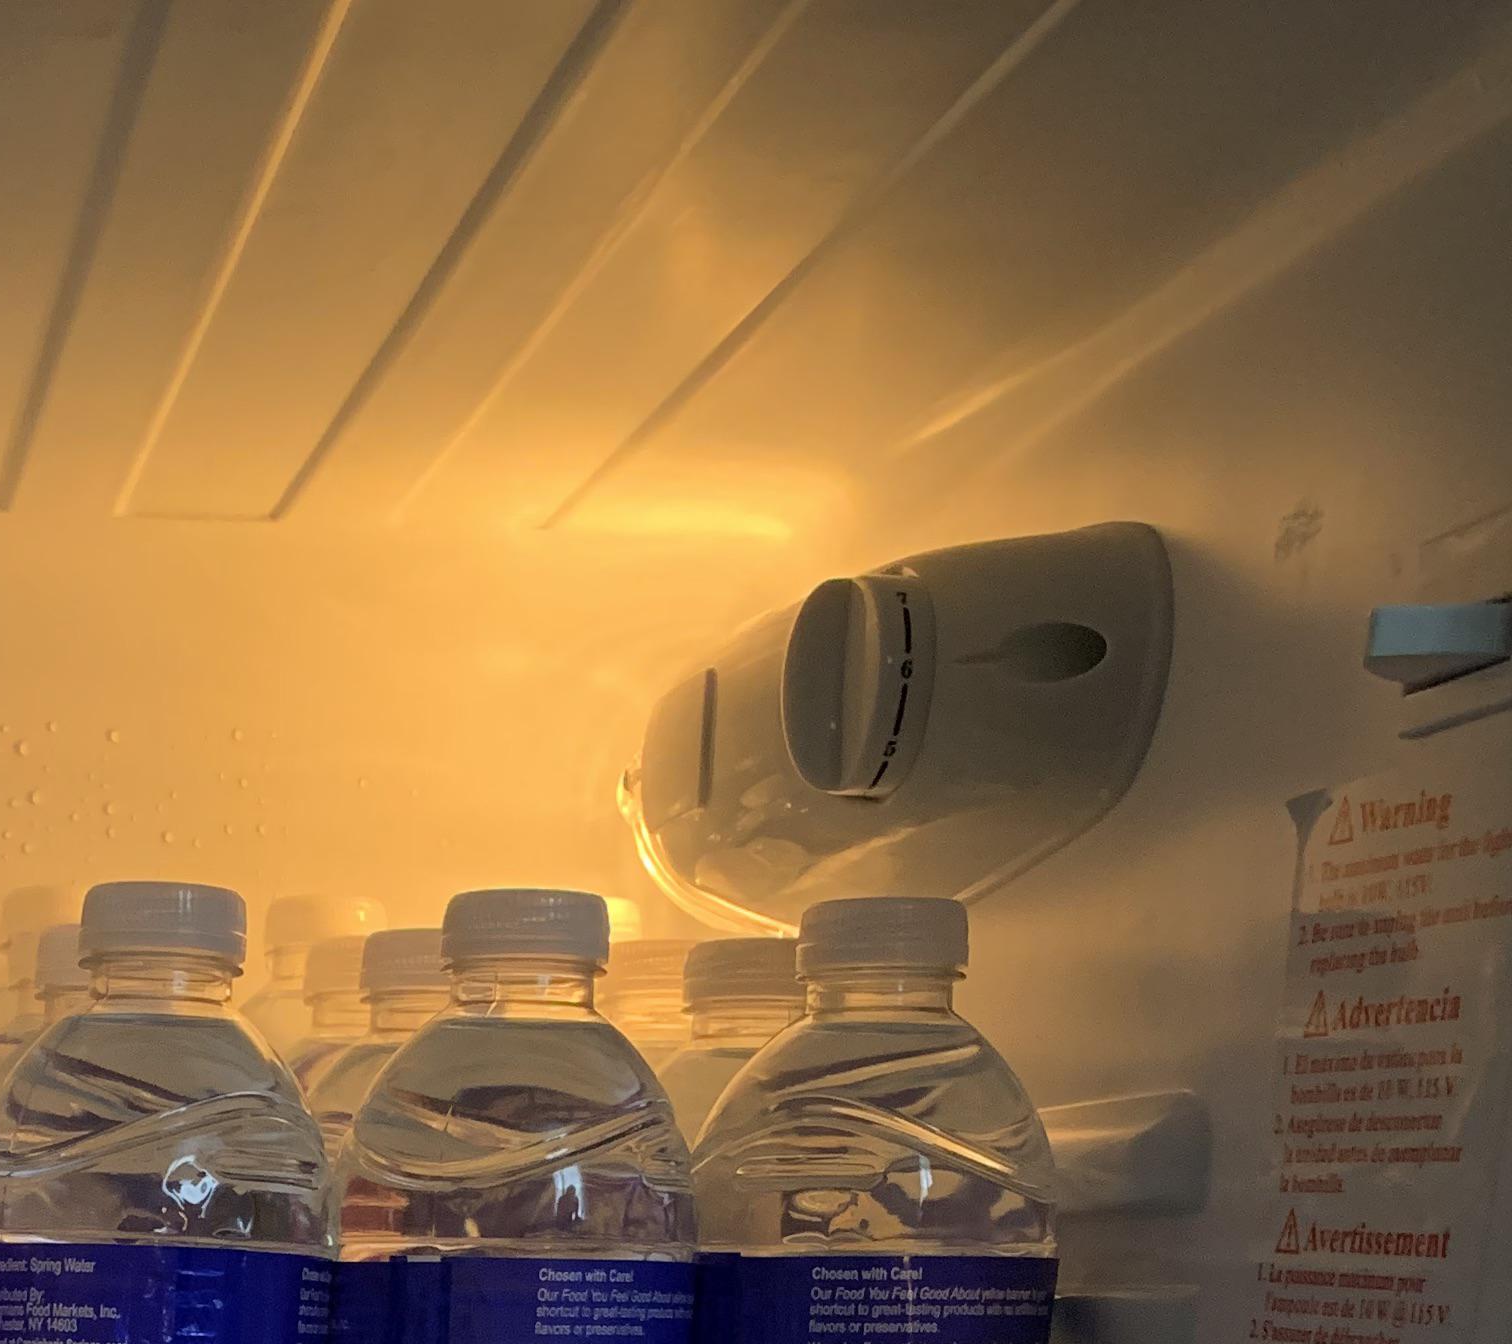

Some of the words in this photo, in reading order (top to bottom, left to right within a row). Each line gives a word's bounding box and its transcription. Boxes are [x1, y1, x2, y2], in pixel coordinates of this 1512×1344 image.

[1360, 789, 1453, 832] Warning
[1332, 985, 1463, 1032] Advertencia
[1302, 1221, 1451, 1260] Avertissement
[29, 1257, 63, 1276] Spring
[64, 1257, 96, 1273] Water
[811, 1266, 859, 1282] Chosen
[861, 1266, 887, 1282] with
[538, 1267, 583, 1282] Chosen
[585, 1268, 607, 1283] with
[537, 1287, 559, 1302] Our
[810, 1286, 832, 1301] Our
[835, 1286, 866, 1301] Food
[868, 1286, 890, 1301] You
[891, 1286, 918, 1301] Feel
[919, 1286, 951, 1302] Good
[26, 1302, 51, 1318] Food
[99, 1303, 121, 1320] Inc.
[809, 1303, 855, 1318] shortcut
[857, 1303, 869, 1317] to
[808, 1319, 846, 1335] flavors
[849, 1321, 862, 1335] or
